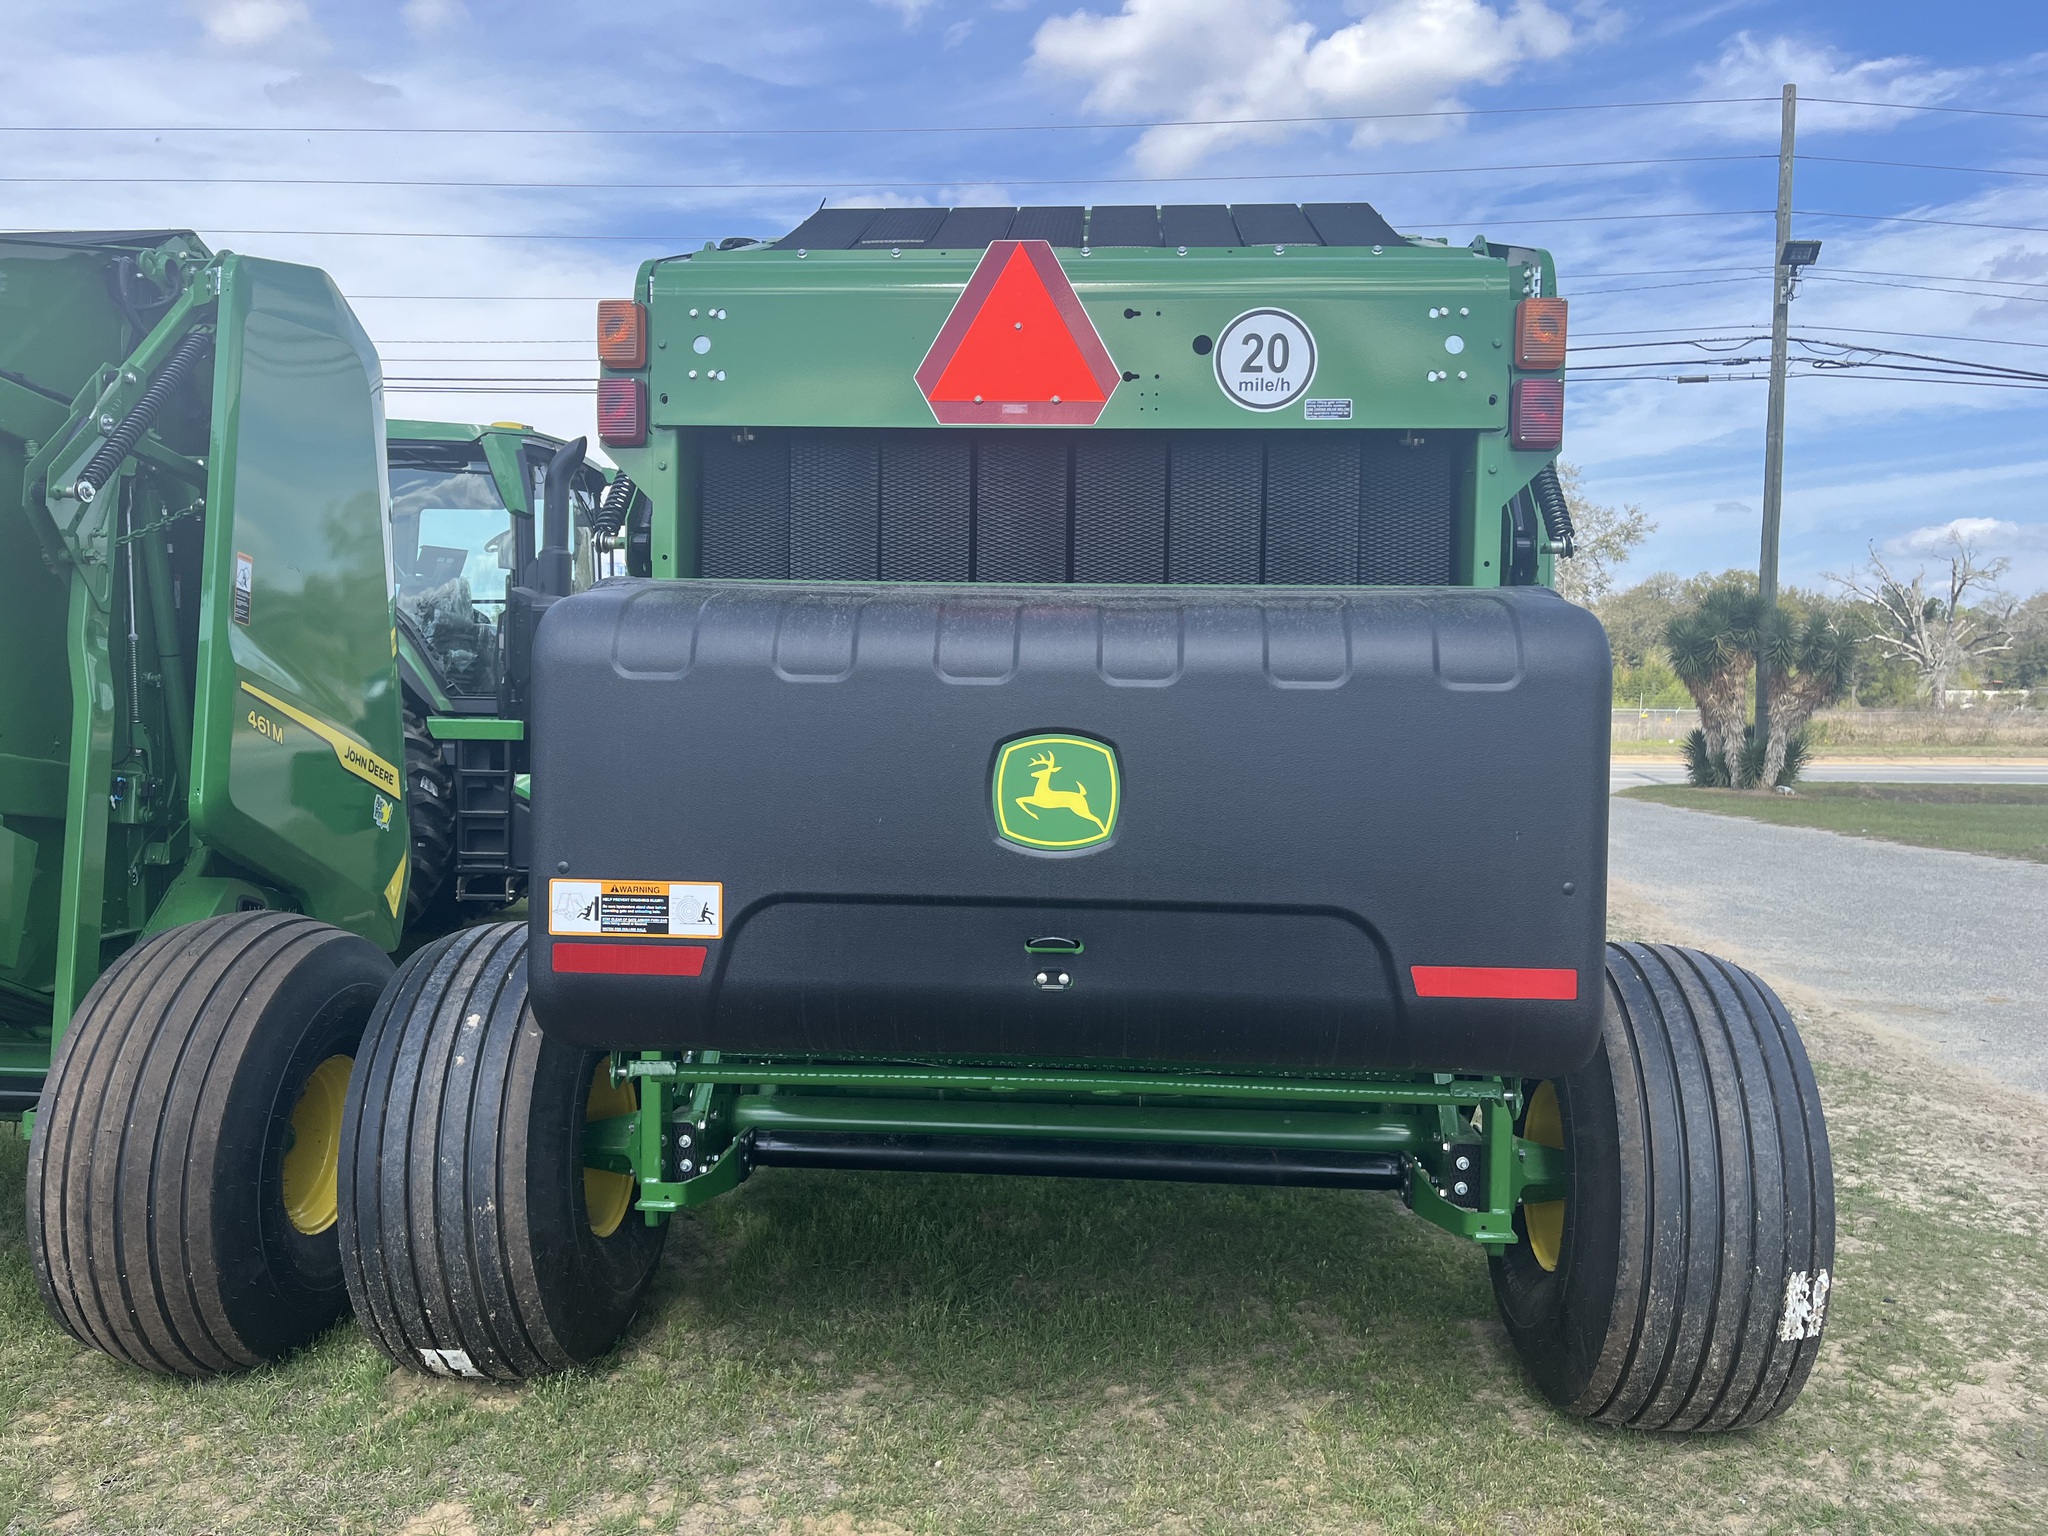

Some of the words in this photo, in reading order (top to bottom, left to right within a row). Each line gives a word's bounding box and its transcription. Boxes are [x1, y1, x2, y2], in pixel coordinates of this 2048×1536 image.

[1240, 333, 1290, 373] 20
[1239, 378, 1290, 392] mile/h
[344, 746, 367, 770] JOHN
[368, 759, 394, 786] DEERE
[619, 886, 660, 894] WARNING
